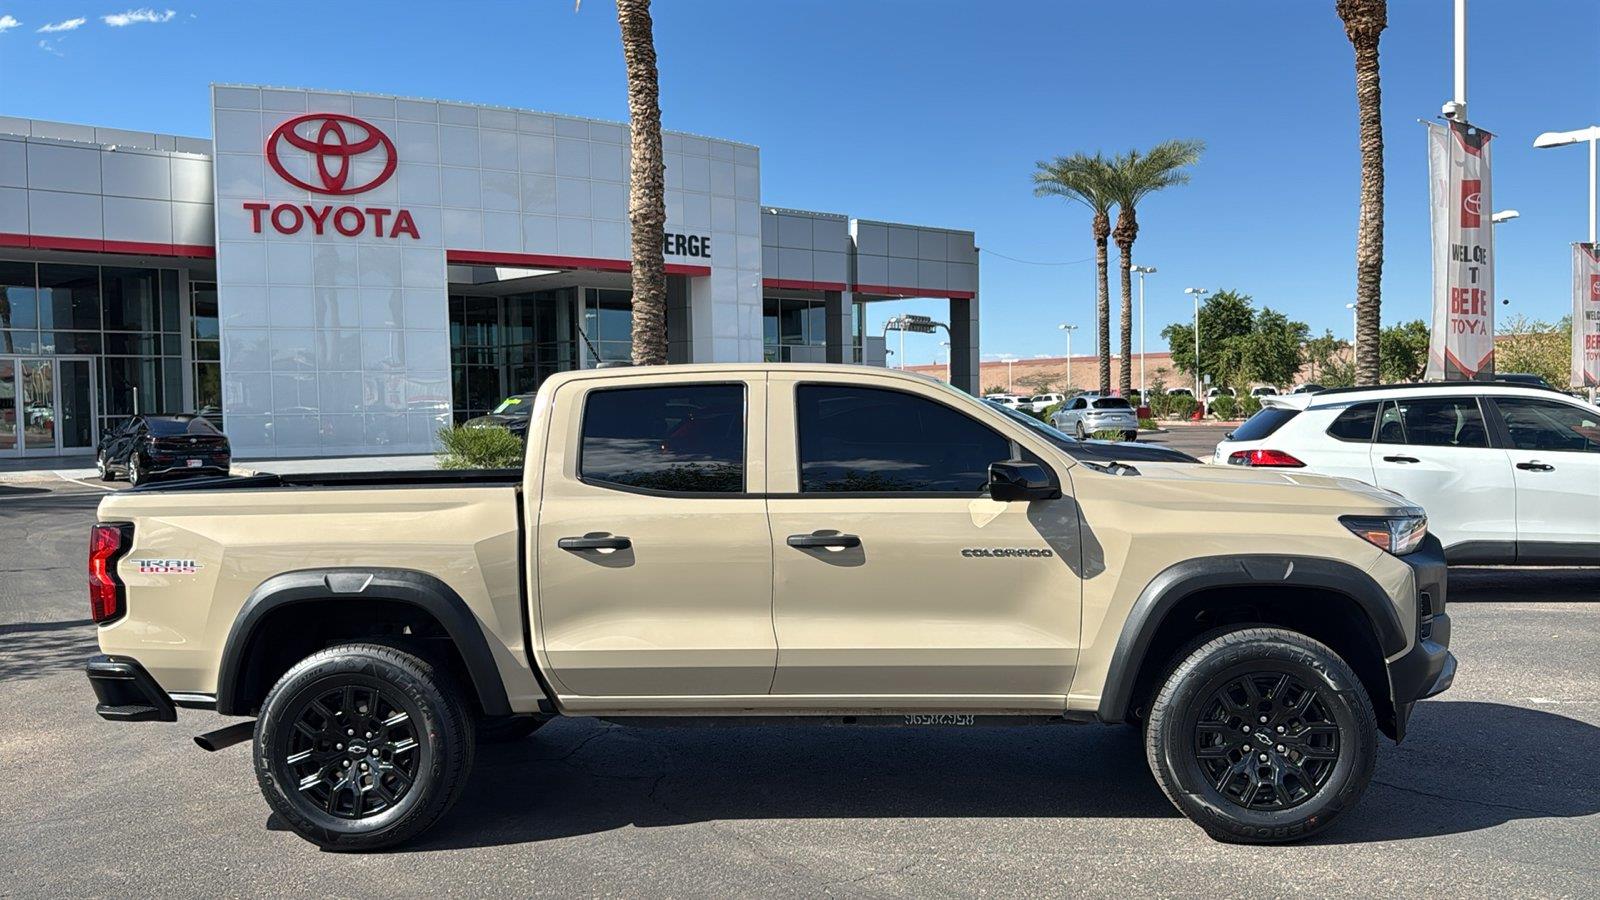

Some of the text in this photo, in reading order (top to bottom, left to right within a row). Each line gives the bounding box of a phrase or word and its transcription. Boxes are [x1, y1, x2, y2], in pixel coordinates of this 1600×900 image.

[243, 203, 420, 239] TOYOTA
[961, 548, 1053, 557] COLORADO
[131, 559, 203, 567] TRAIL
